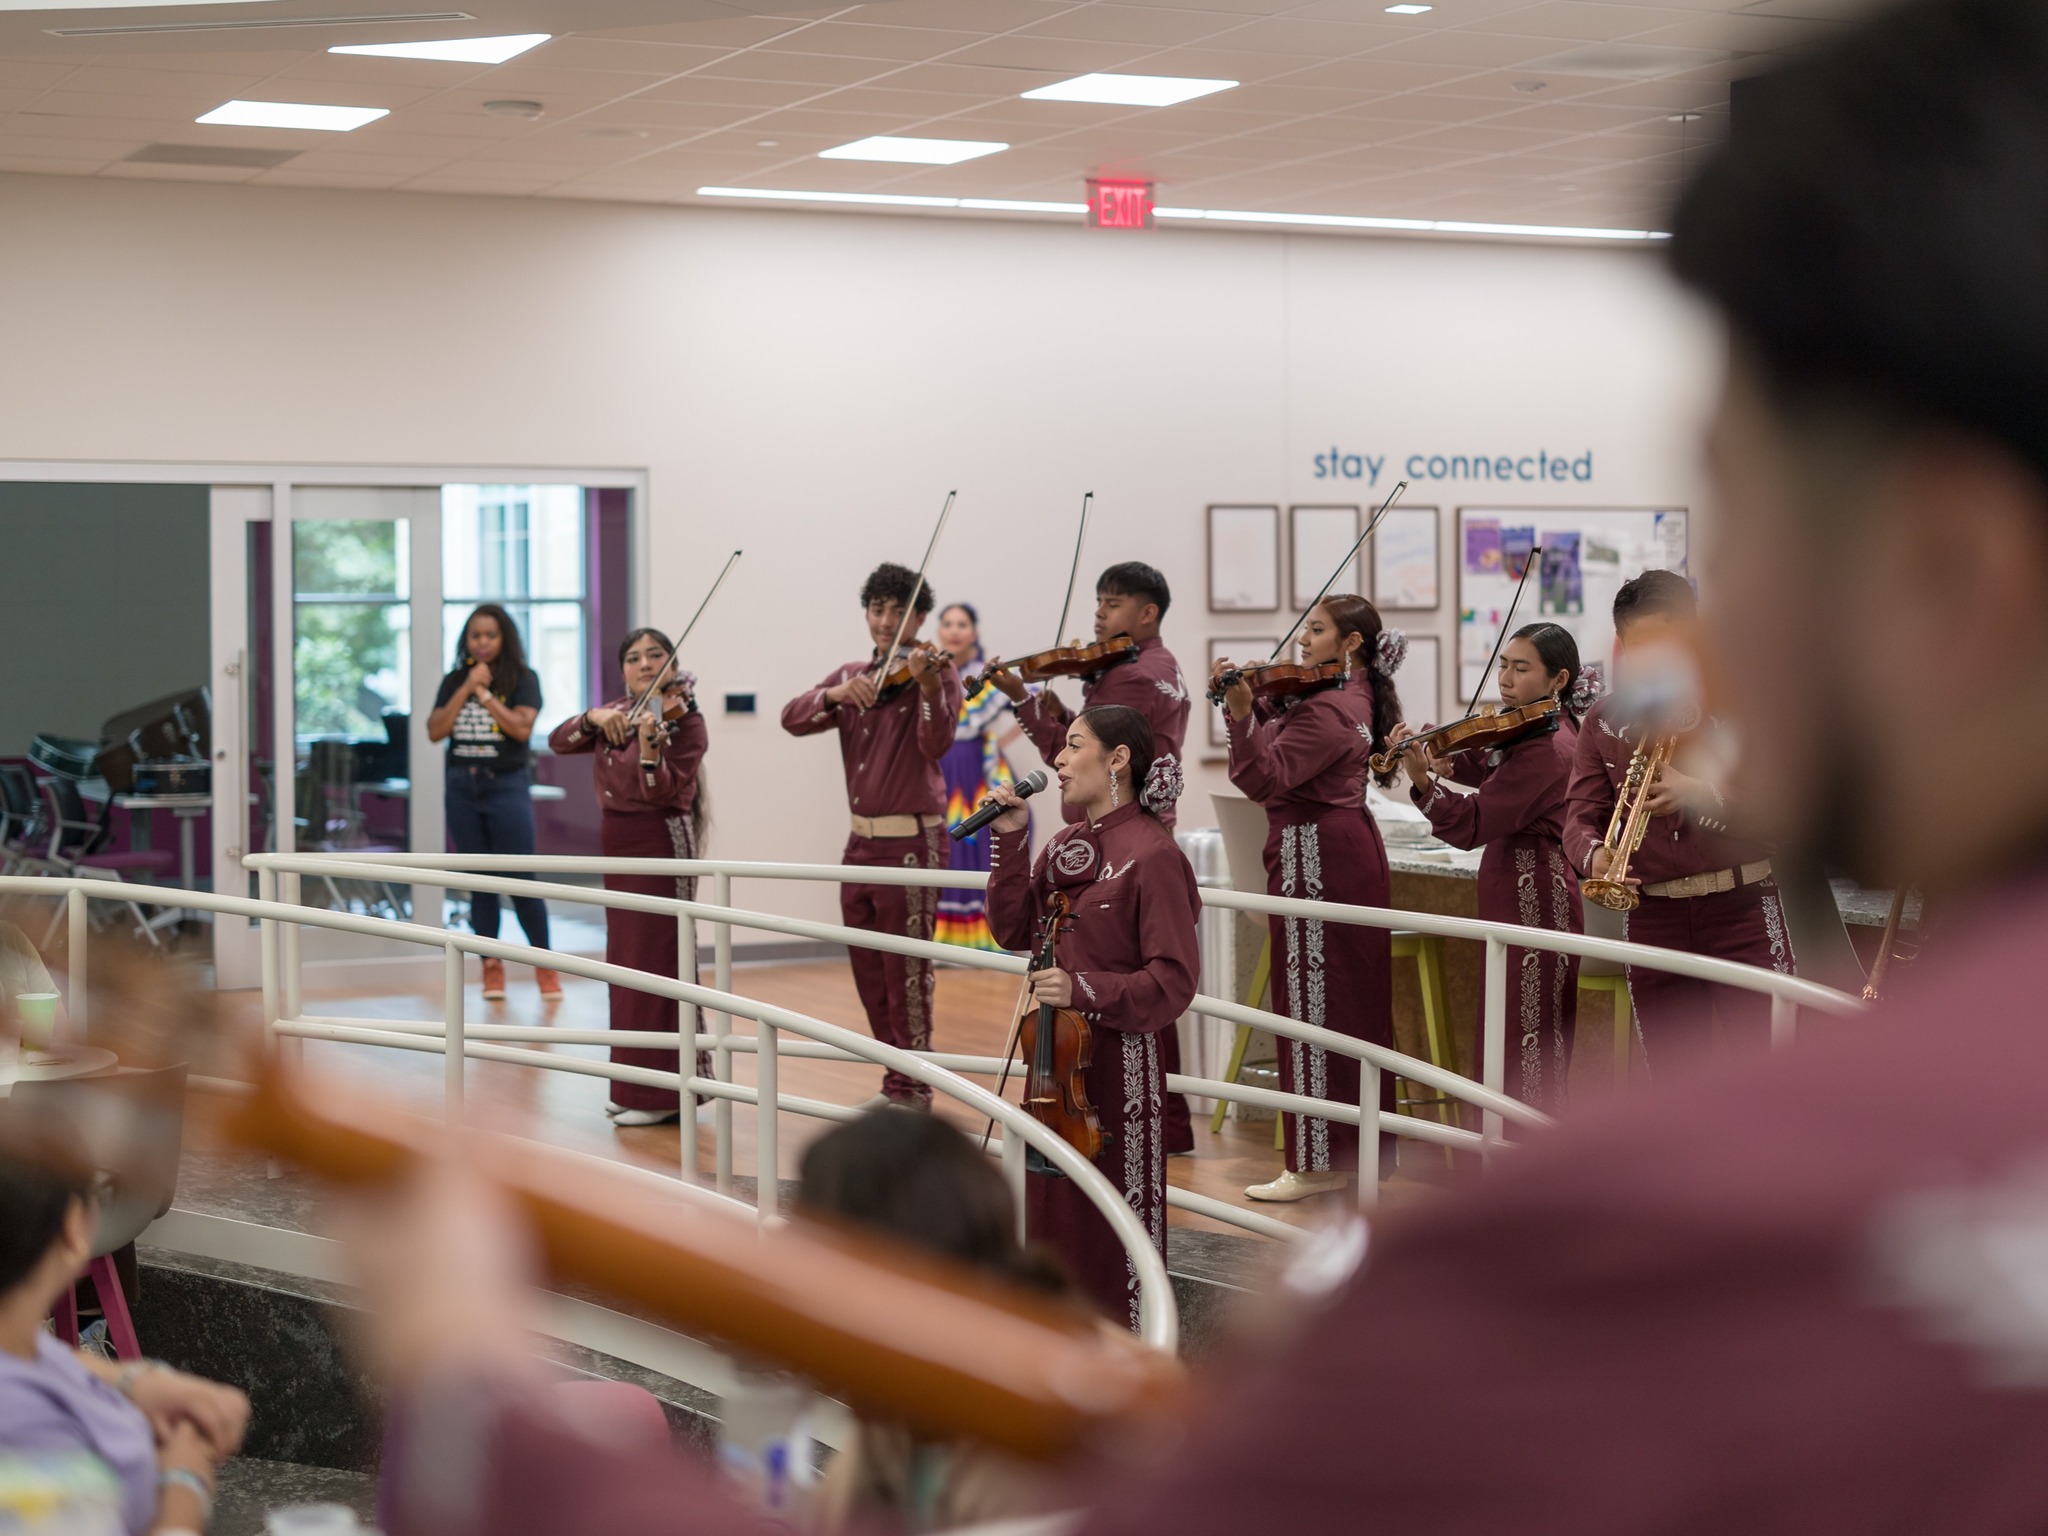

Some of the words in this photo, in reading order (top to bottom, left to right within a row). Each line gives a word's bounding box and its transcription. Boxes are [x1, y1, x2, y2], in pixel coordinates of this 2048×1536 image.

[1099, 187, 1145, 227] EXIT
[1313, 447, 1384, 488] stay
[1405, 449, 1592, 482] connected
